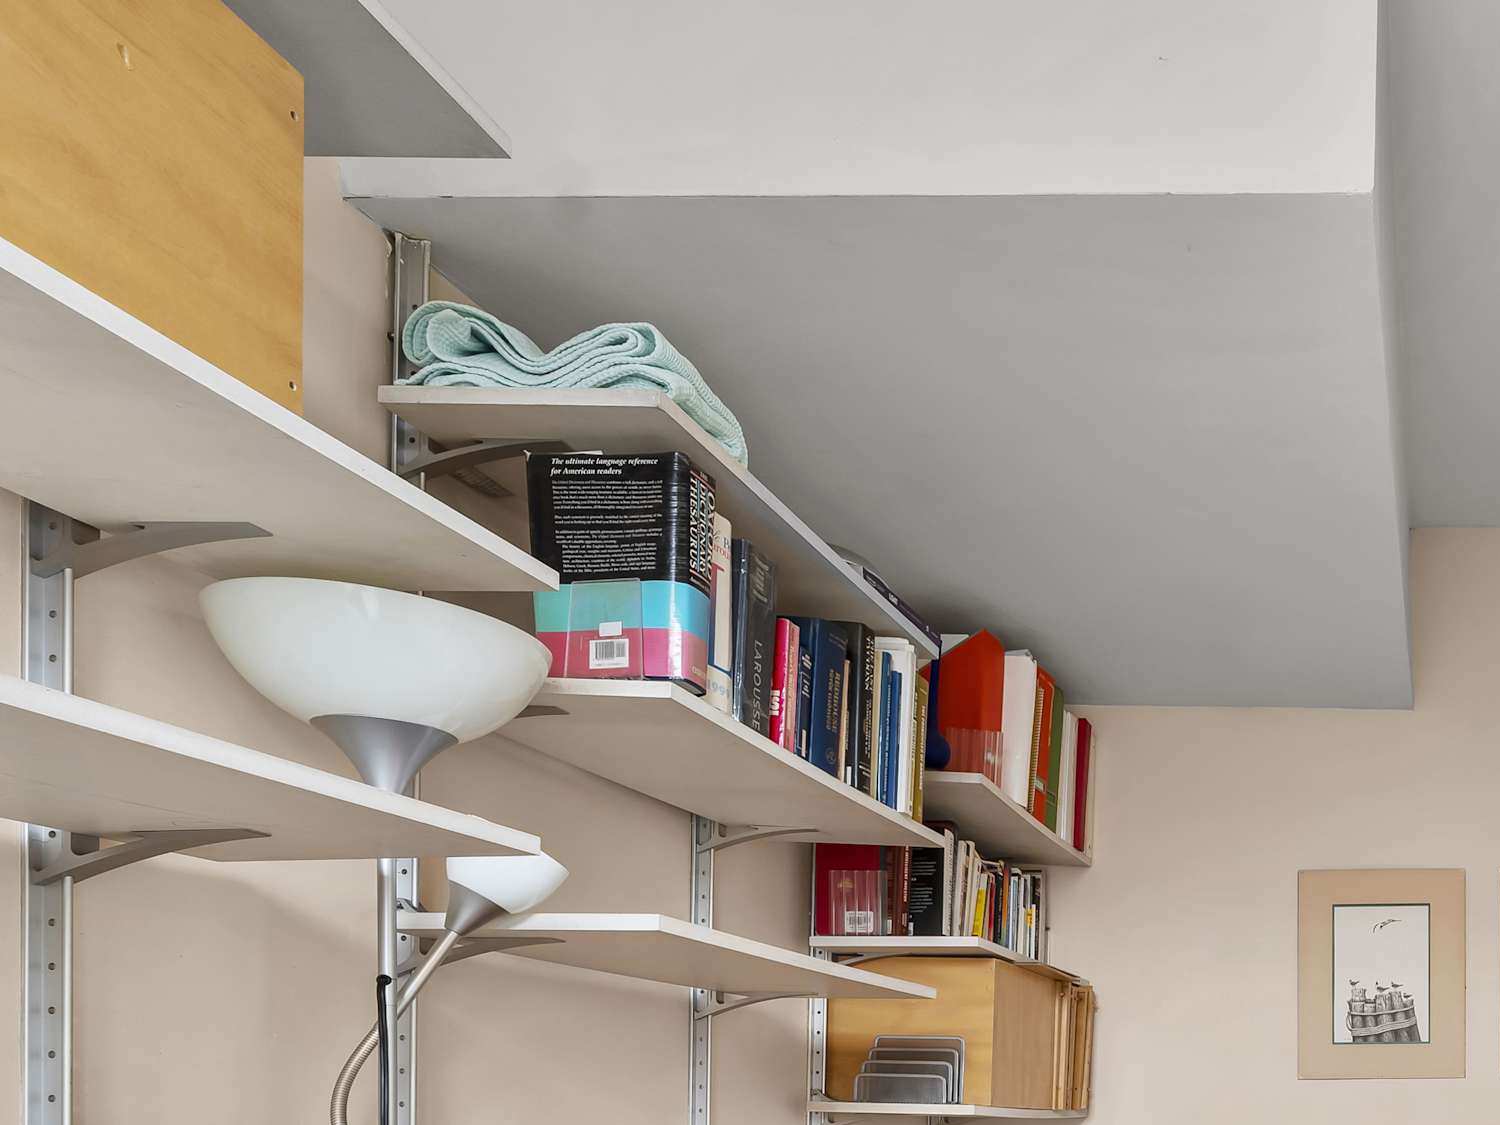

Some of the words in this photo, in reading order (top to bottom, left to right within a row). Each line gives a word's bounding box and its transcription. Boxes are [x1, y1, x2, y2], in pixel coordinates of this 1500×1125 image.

[550, 467, 562, 477] for
[563, 467, 595, 475] American
[596, 467, 622, 475] readers
[551, 457, 563, 465] The
[565, 457, 595, 465] ultimate
[596, 457, 627, 467] language
[628, 457, 659, 467] reference
[689, 477, 698, 570] THESAURUS
[752, 639, 763, 731] LAROUSSE
